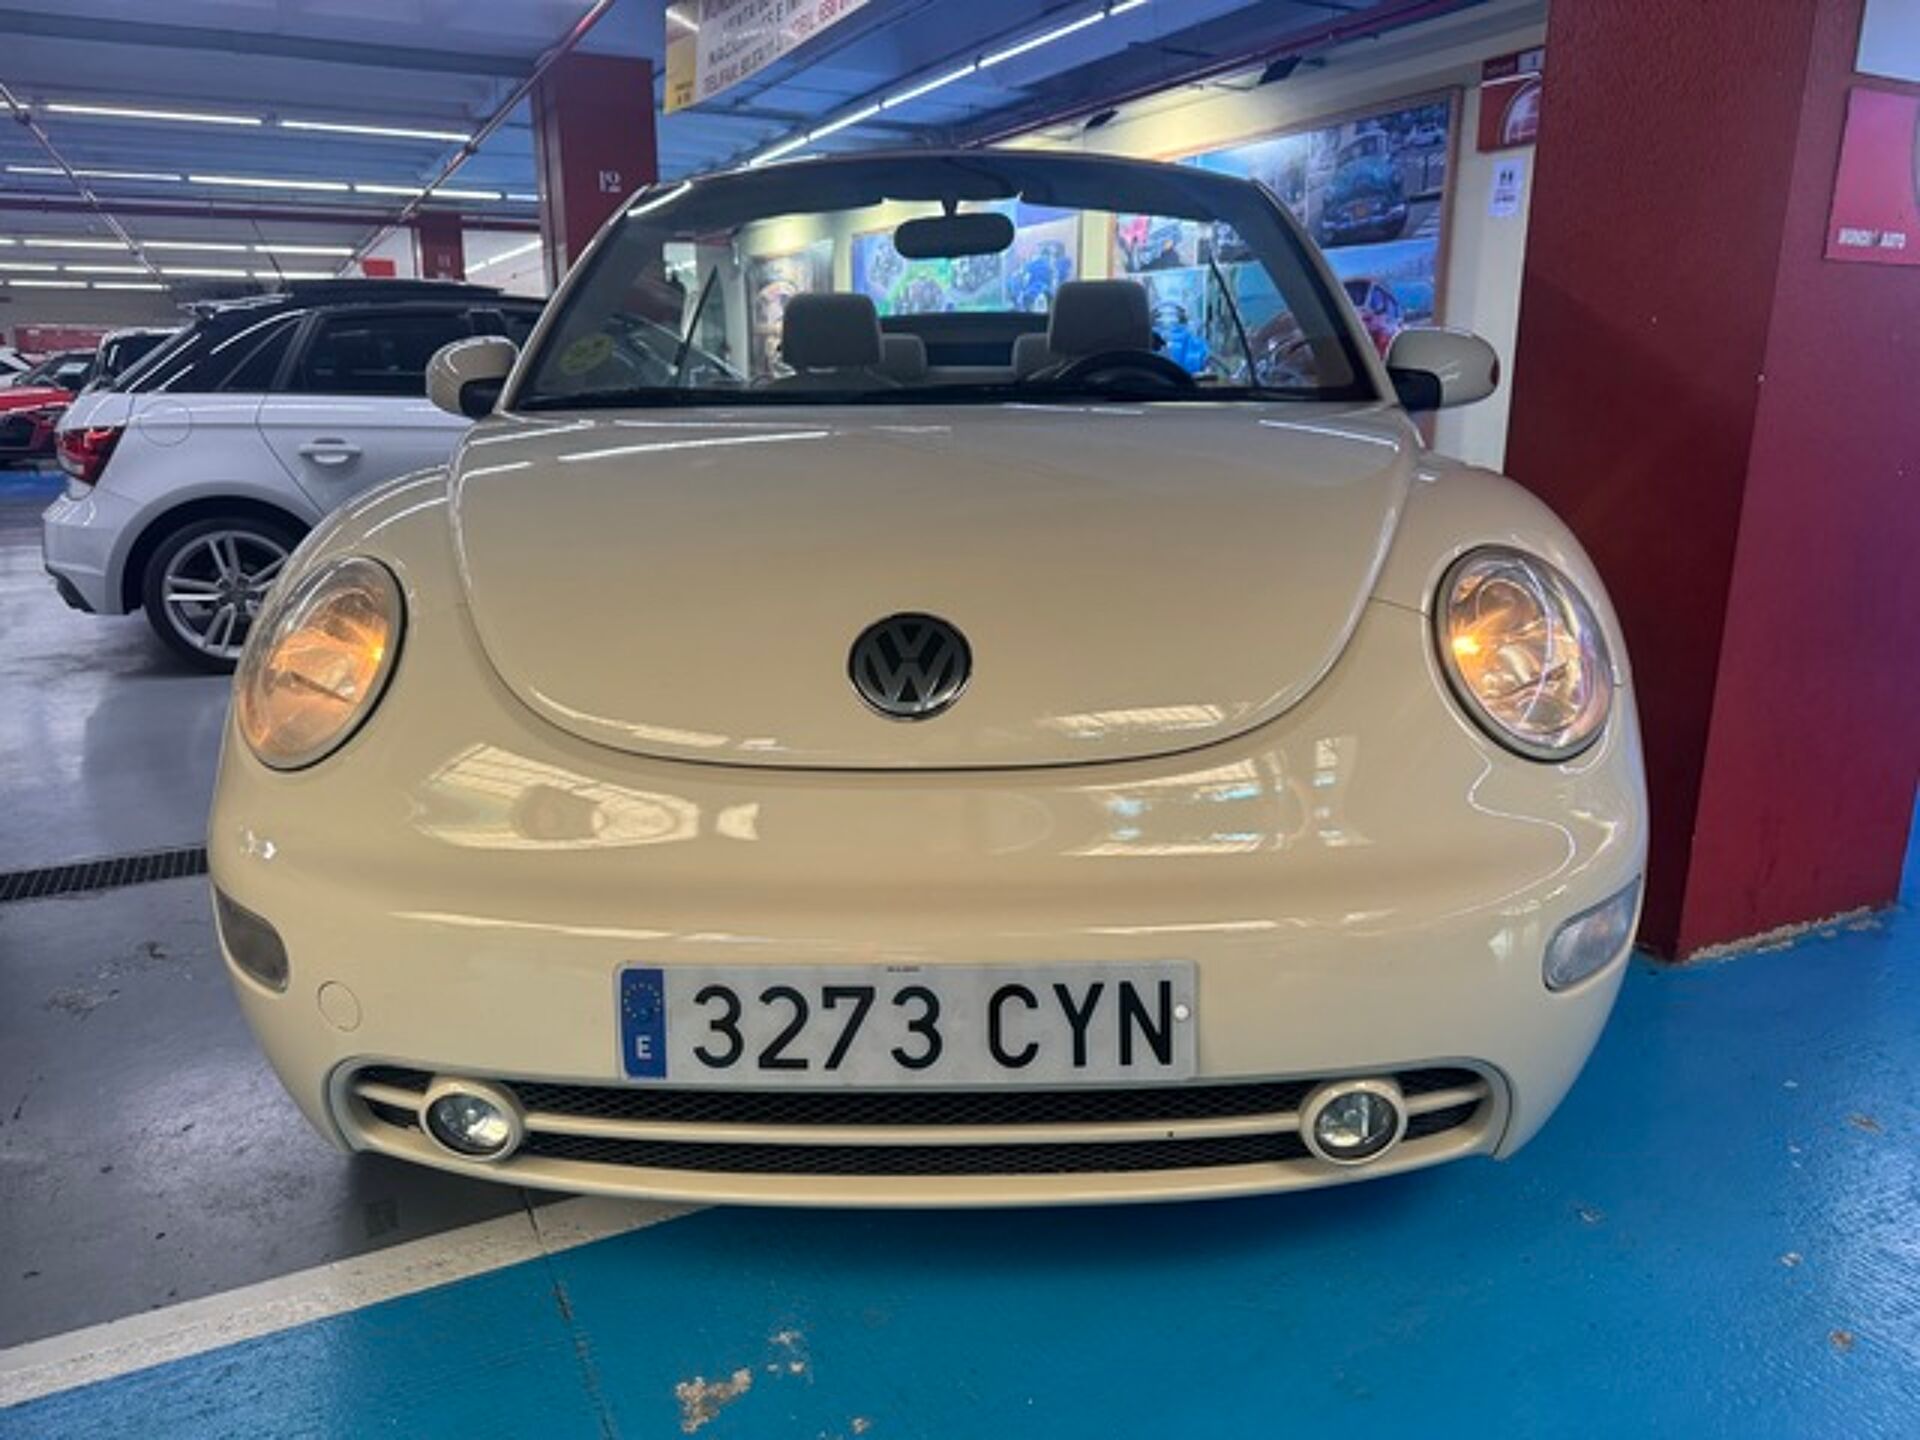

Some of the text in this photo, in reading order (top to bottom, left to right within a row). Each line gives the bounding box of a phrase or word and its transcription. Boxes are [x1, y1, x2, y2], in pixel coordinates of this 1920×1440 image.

[636, 980, 1173, 1071] E 3273 CYN
